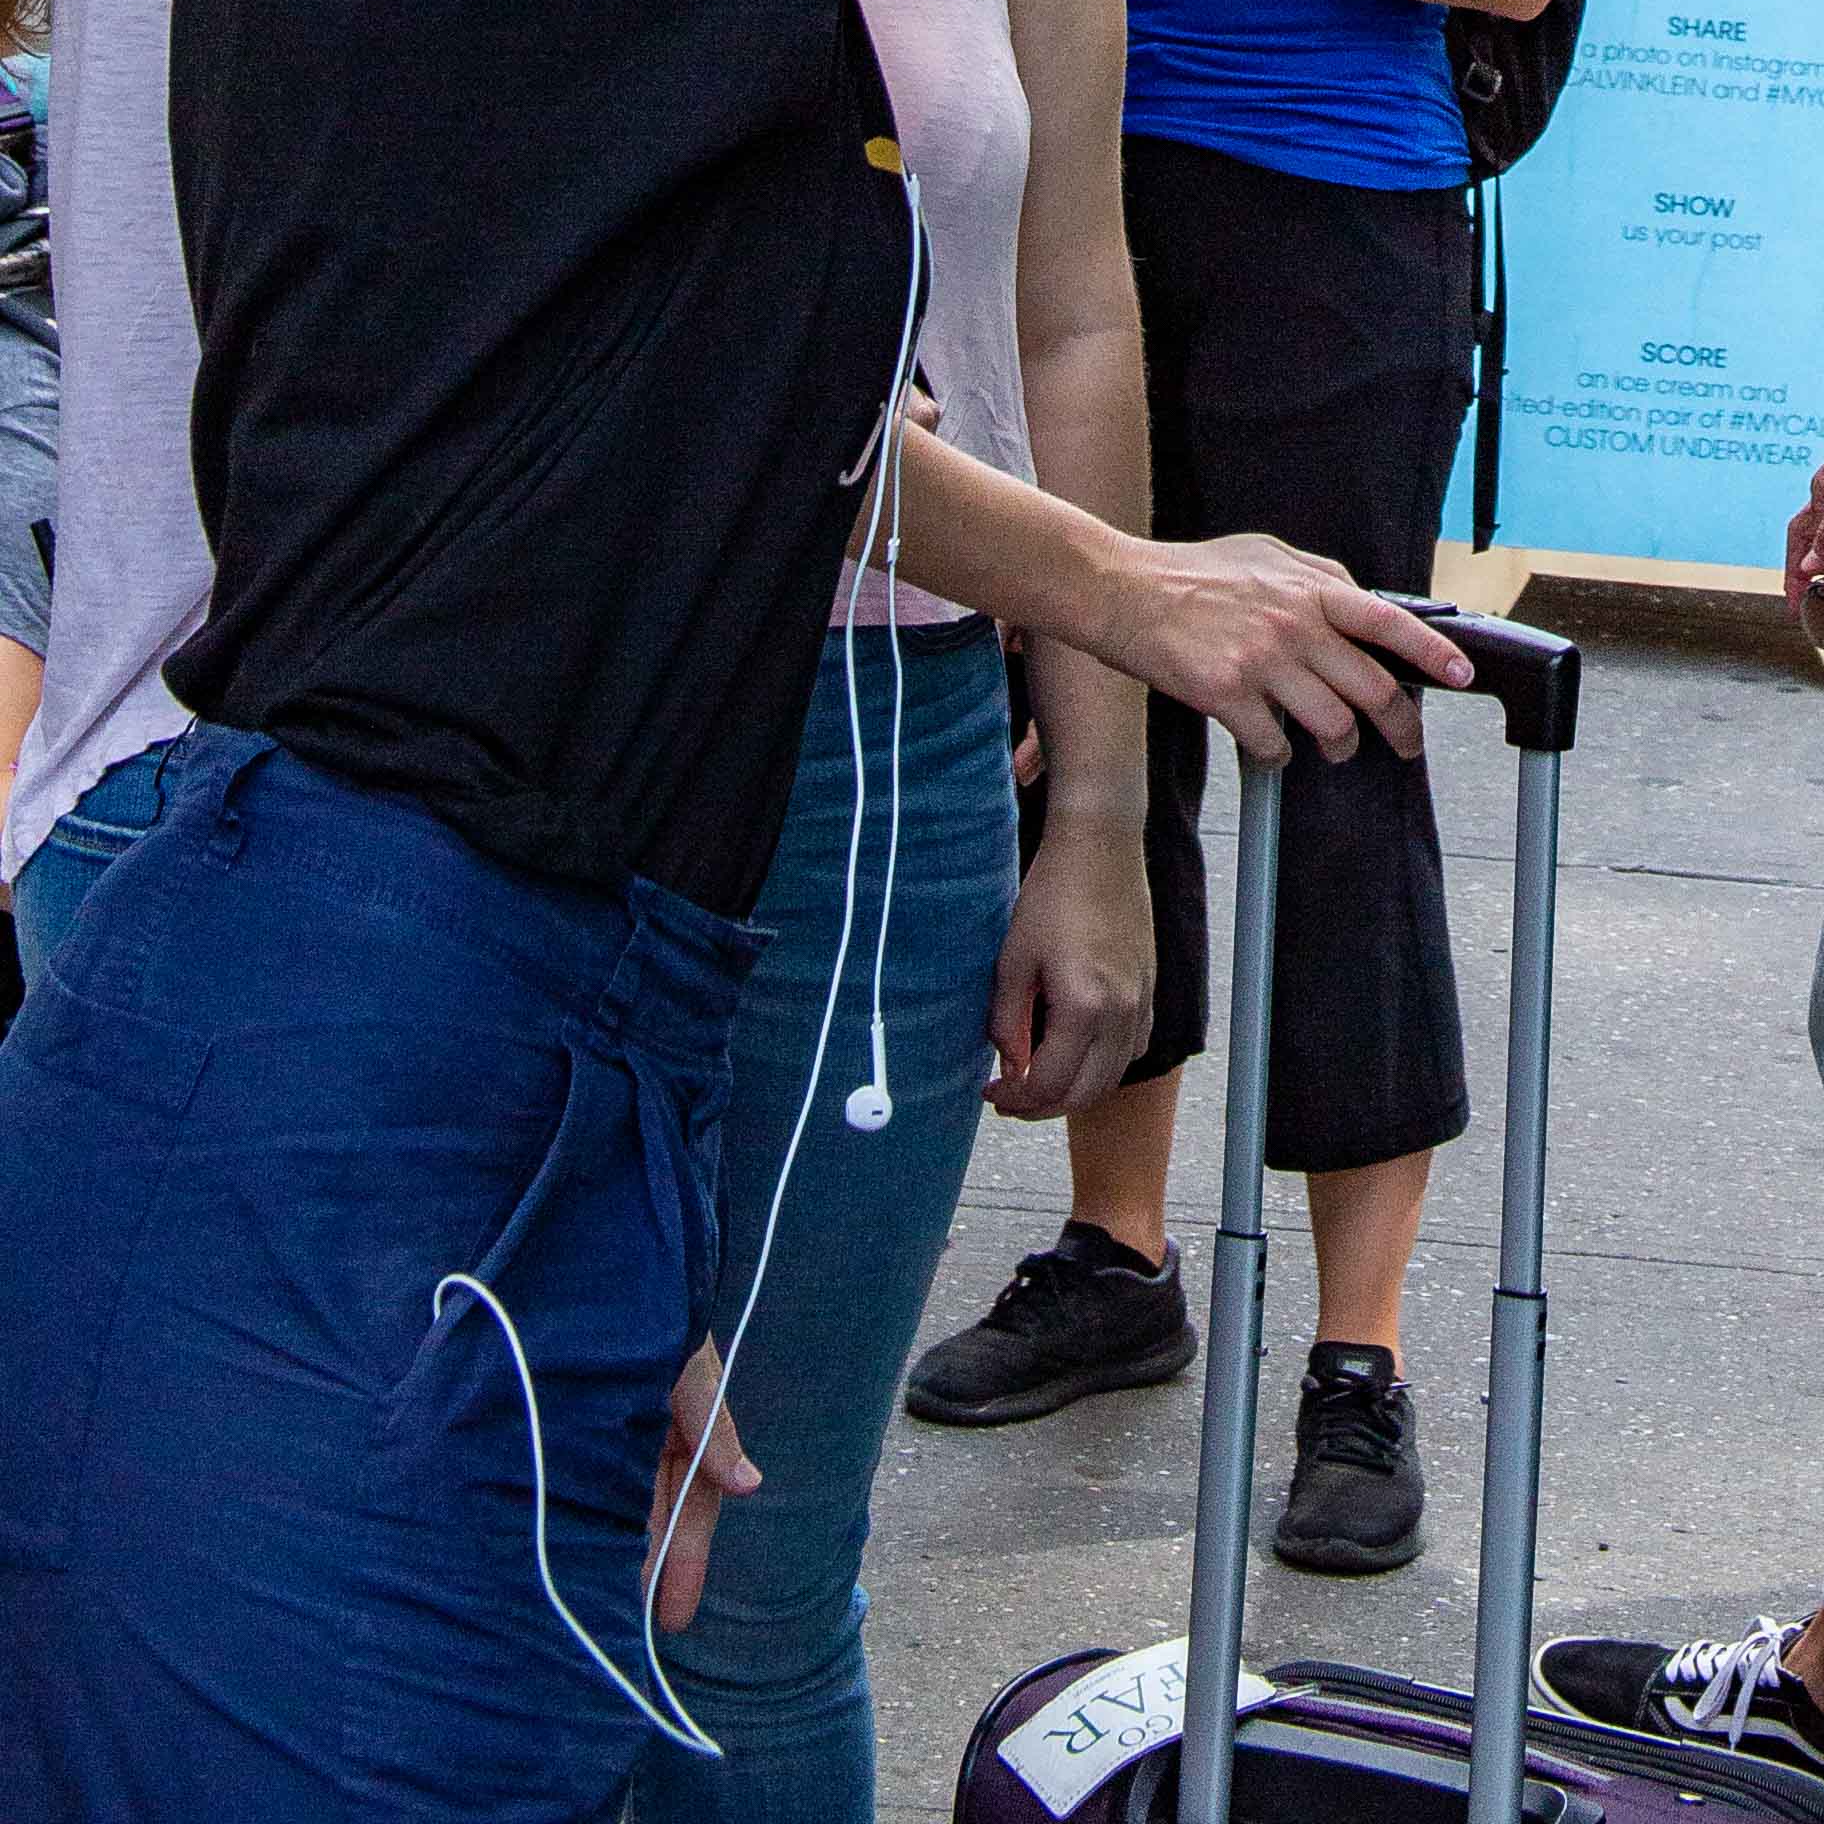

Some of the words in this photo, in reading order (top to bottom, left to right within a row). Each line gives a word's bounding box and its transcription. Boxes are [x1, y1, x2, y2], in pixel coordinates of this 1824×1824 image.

[1667, 15, 1748, 42] SHARE
[1602, 41, 1673, 67] photo
[1676, 50, 1709, 69] on
[1712, 81, 1761, 103] and
[1654, 192, 1736, 218] SHOW
[1623, 225, 1649, 242] us
[1655, 227, 1706, 248] your
[1711, 231, 1763, 252] post
[1641, 341, 1728, 369] SCORE
[1576, 372, 1610, 389] an
[1613, 373, 1651, 393] ice
[1655, 378, 1734, 399] cream
[1739, 383, 1788, 405] and
[1647, 406, 1695, 430] pair
[1699, 408, 1726, 429] of
[1544, 425, 1654, 454] CUSTOM
[1657, 432, 1812, 467] UNDERWEAR
[1118, 1714, 1173, 1747] GO
